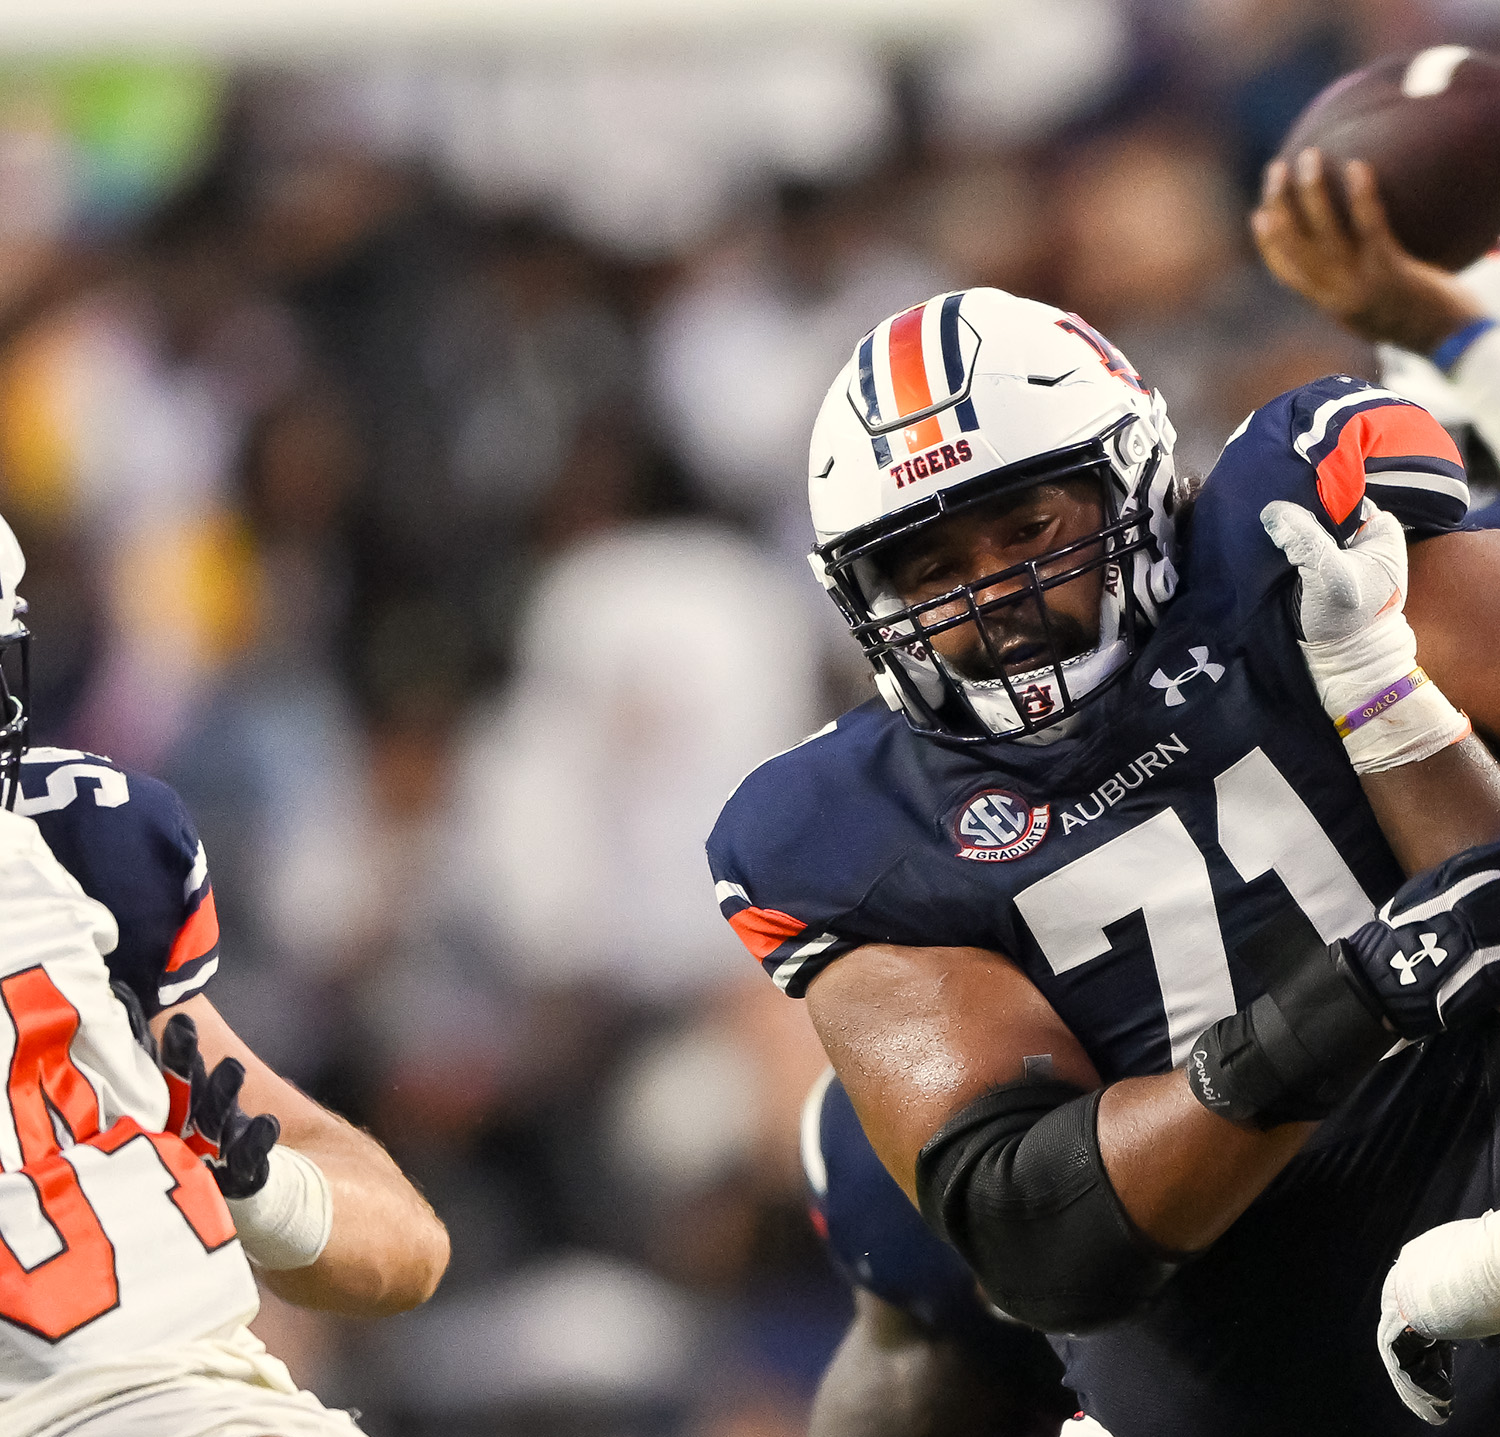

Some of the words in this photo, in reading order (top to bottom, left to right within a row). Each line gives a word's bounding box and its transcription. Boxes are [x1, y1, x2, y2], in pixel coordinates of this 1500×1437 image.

[889, 439, 973, 490] TIGERS
[1059, 732, 1190, 836] AUBURN
[960, 794, 1026, 846] SEC
[976, 821, 1047, 860] GRADUATE
[1012, 746, 1377, 1069] 71
